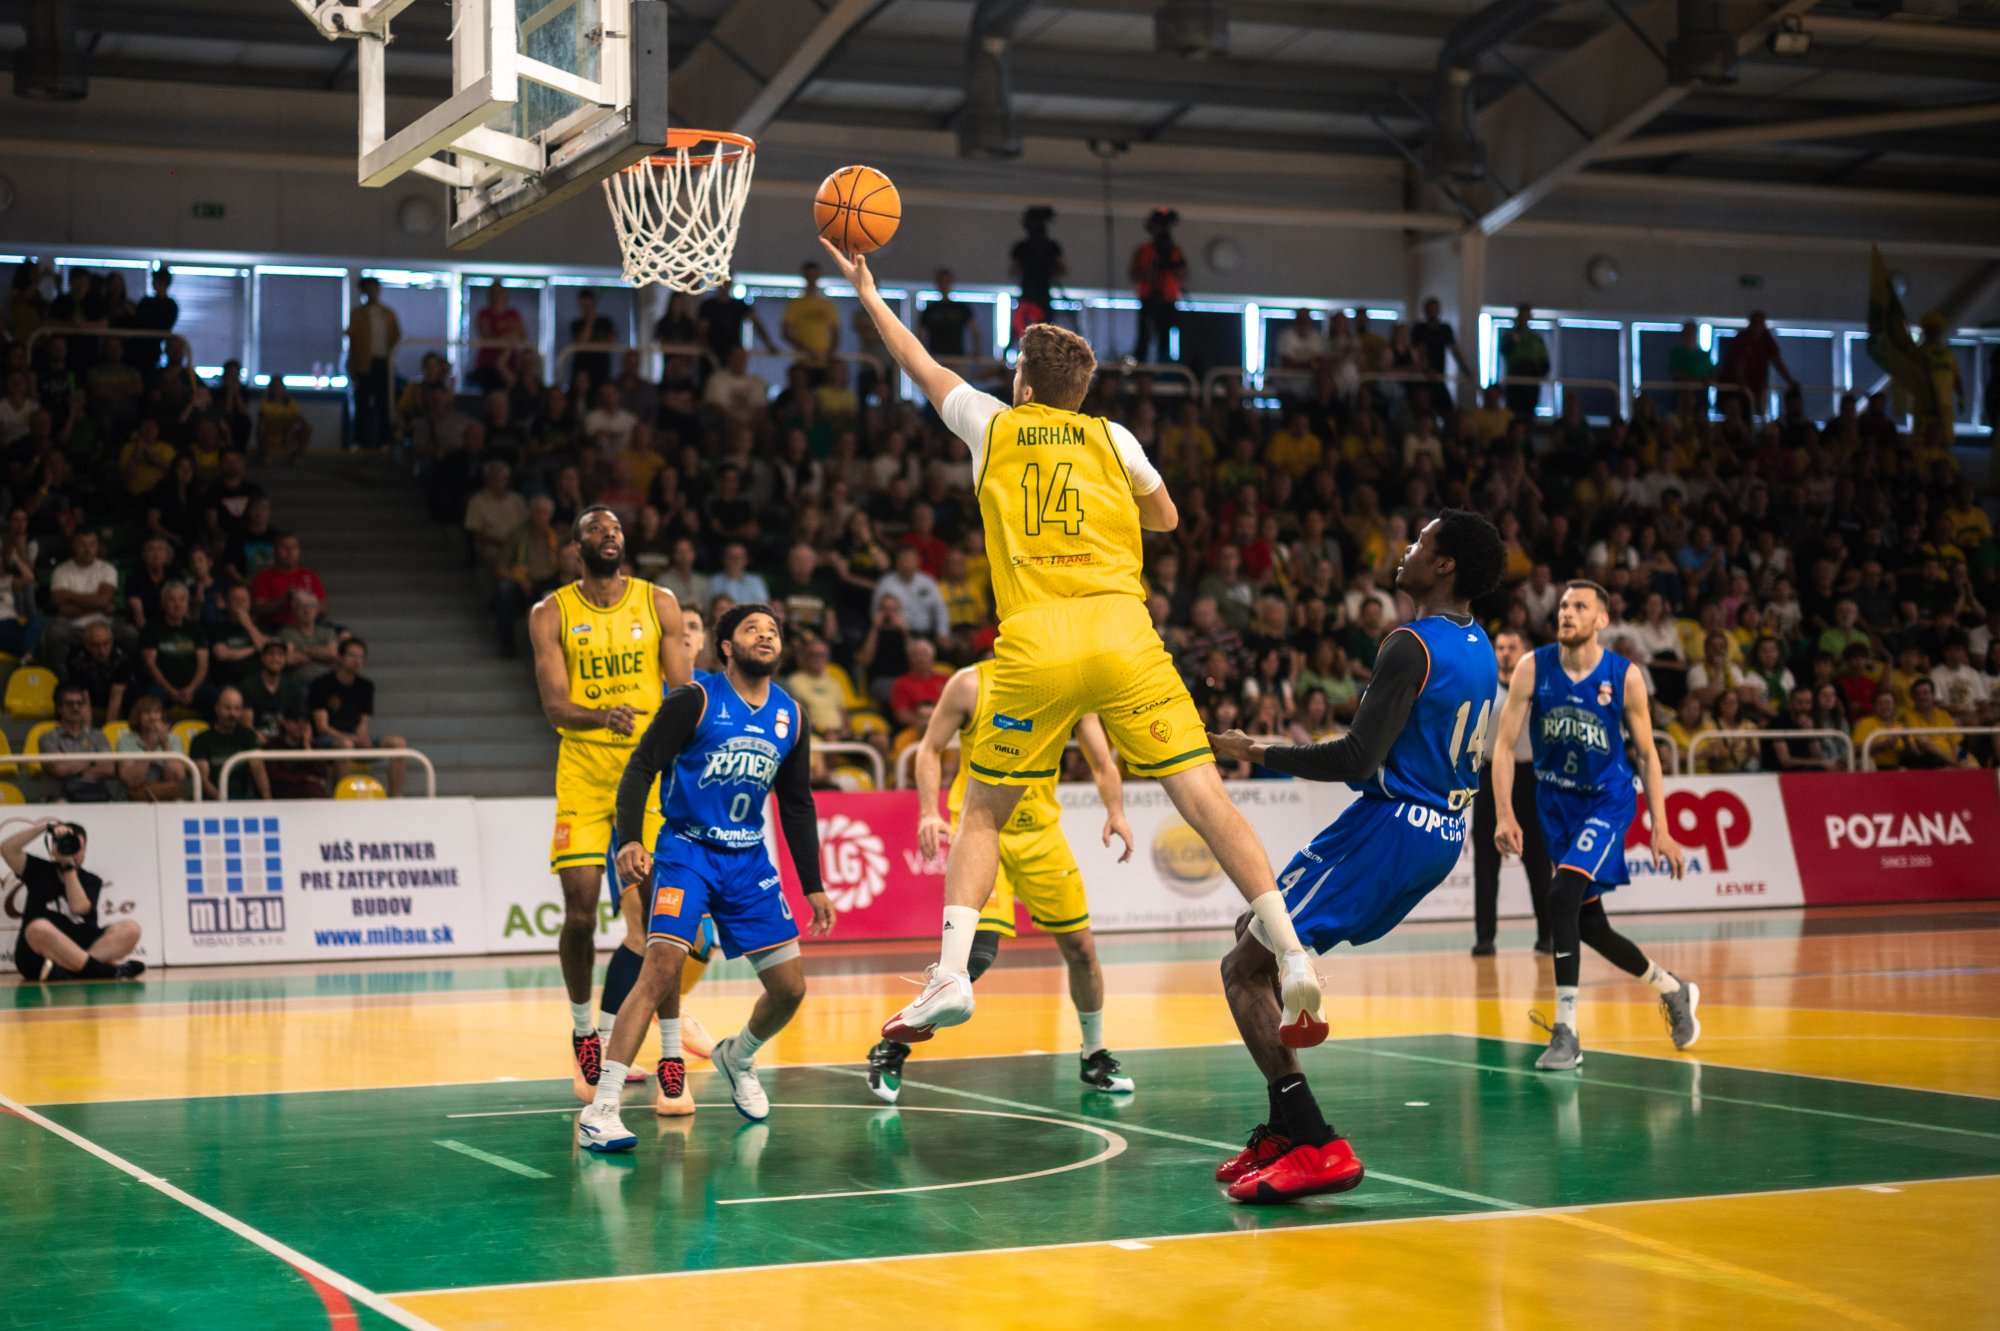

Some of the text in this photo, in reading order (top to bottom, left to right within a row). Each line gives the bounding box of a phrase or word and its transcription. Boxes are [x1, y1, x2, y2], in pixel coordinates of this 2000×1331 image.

[1017, 423, 1085, 446] ABRHÁM
[1021, 462, 1084, 536] 14
[579, 651, 644, 680] LEVICE
[1544, 717, 1608, 750] RYTIERI
[994, 743, 1021, 756] VIALLE
[1564, 751, 1578, 774] 6
[729, 793, 751, 822] 0
[1576, 828, 1597, 852] 6
[1825, 811, 1974, 849] POZANA
[319, 840, 436, 863] VÁŠ PARTNER
[824, 839, 863, 884] LG
[300, 868, 459, 890] PRE ZATEPĽOVANIE
[191, 898, 282, 931] mibau
[352, 898, 412, 916] BUDOV
[315, 924, 453, 947] www.mibau.sk
